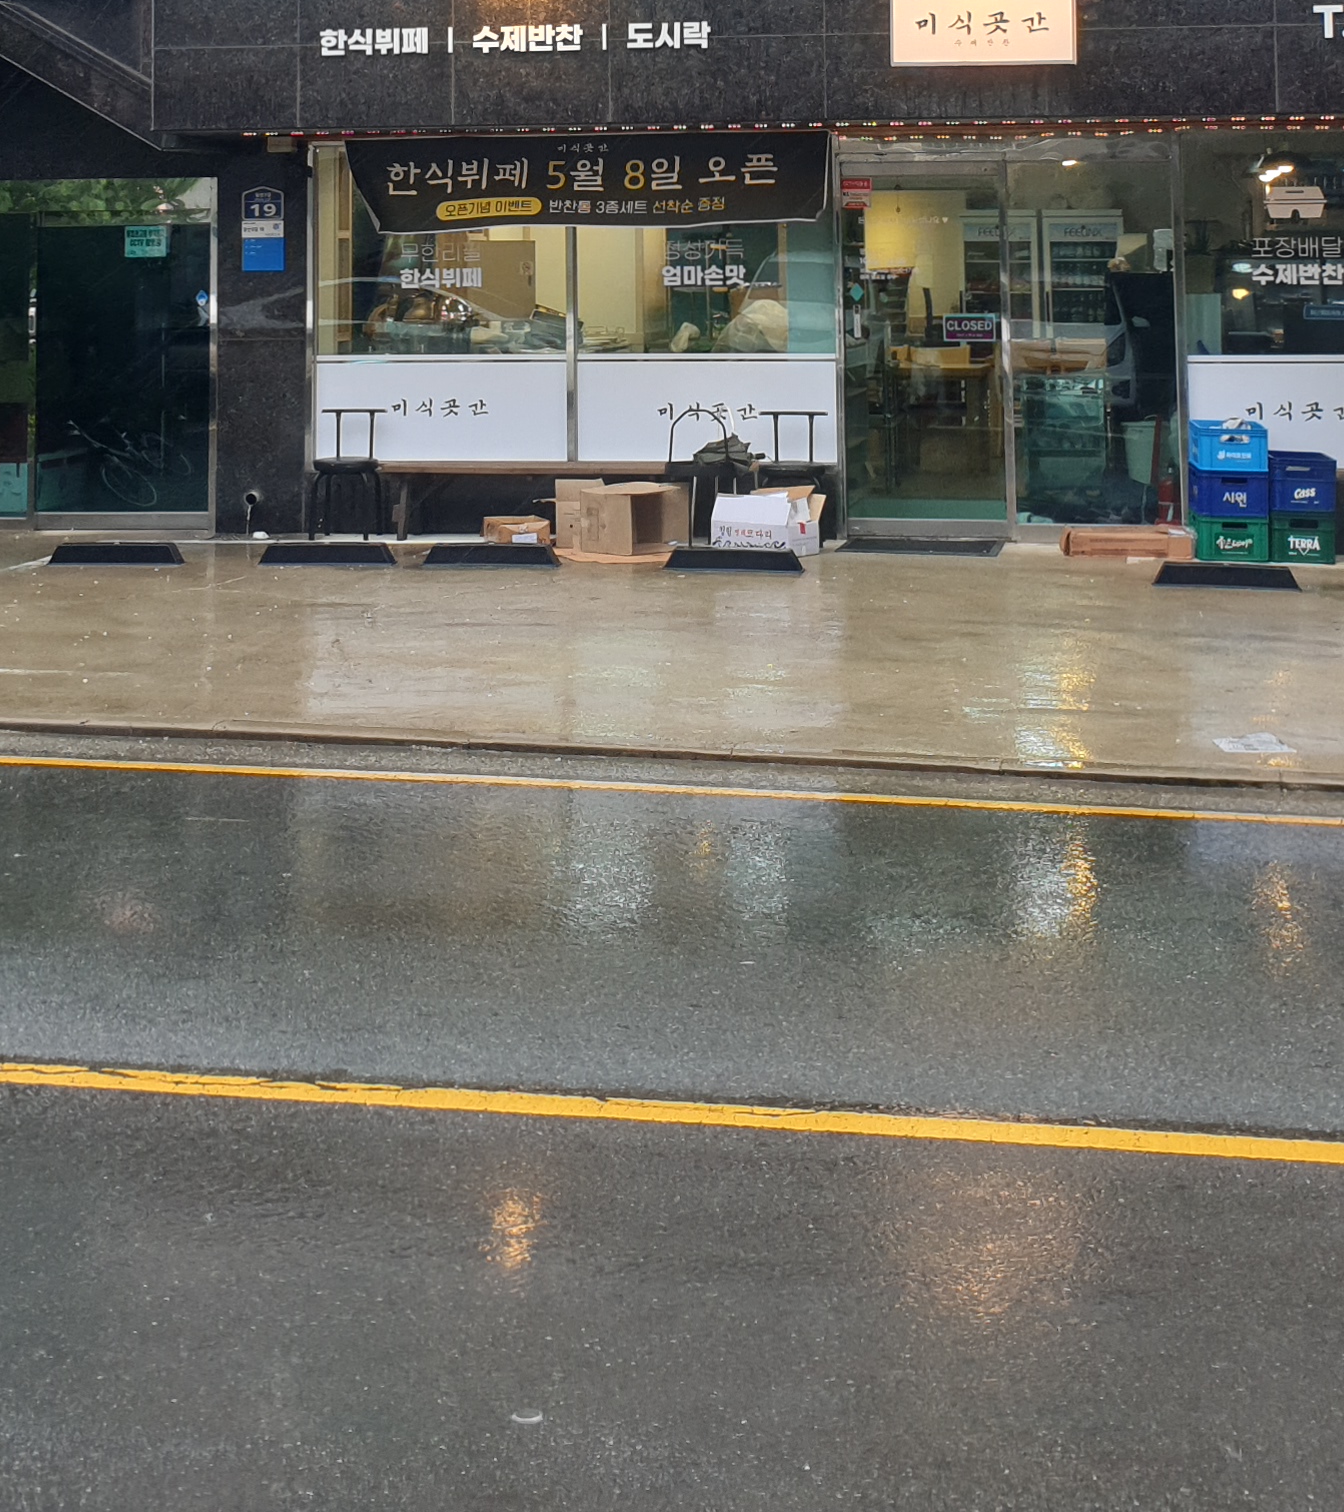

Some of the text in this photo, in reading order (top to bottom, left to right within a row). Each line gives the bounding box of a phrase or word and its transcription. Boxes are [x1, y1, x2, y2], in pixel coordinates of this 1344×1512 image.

[915, 10, 1050, 36] 미식곳간
[319, 20, 711, 56] 한식뷔페 수제반찬 도시락
[557, 142, 610, 153] 미식곳간
[386, 152, 779, 196] 한식뷔페 5월 8일 오픈
[250, 203, 277, 217] 19
[444, 199, 492, 217] 오픈기념
[494, 198, 533, 213] 이벤트
[595, 199, 648, 215] 3종세트
[652, 198, 695, 214] 선착순
[400, 242, 482, 262] 무한리필
[666, 238, 745, 261] 정성가득
[1251, 236, 1344, 258] 포장배달
[399, 266, 483, 289] 한식뷔페
[662, 265, 747, 287] 엄마손맛
[946, 319, 993, 331] CLOSED
[391, 398, 490, 418] 미식곳간
[1287, 534, 1321, 551] TERRA
